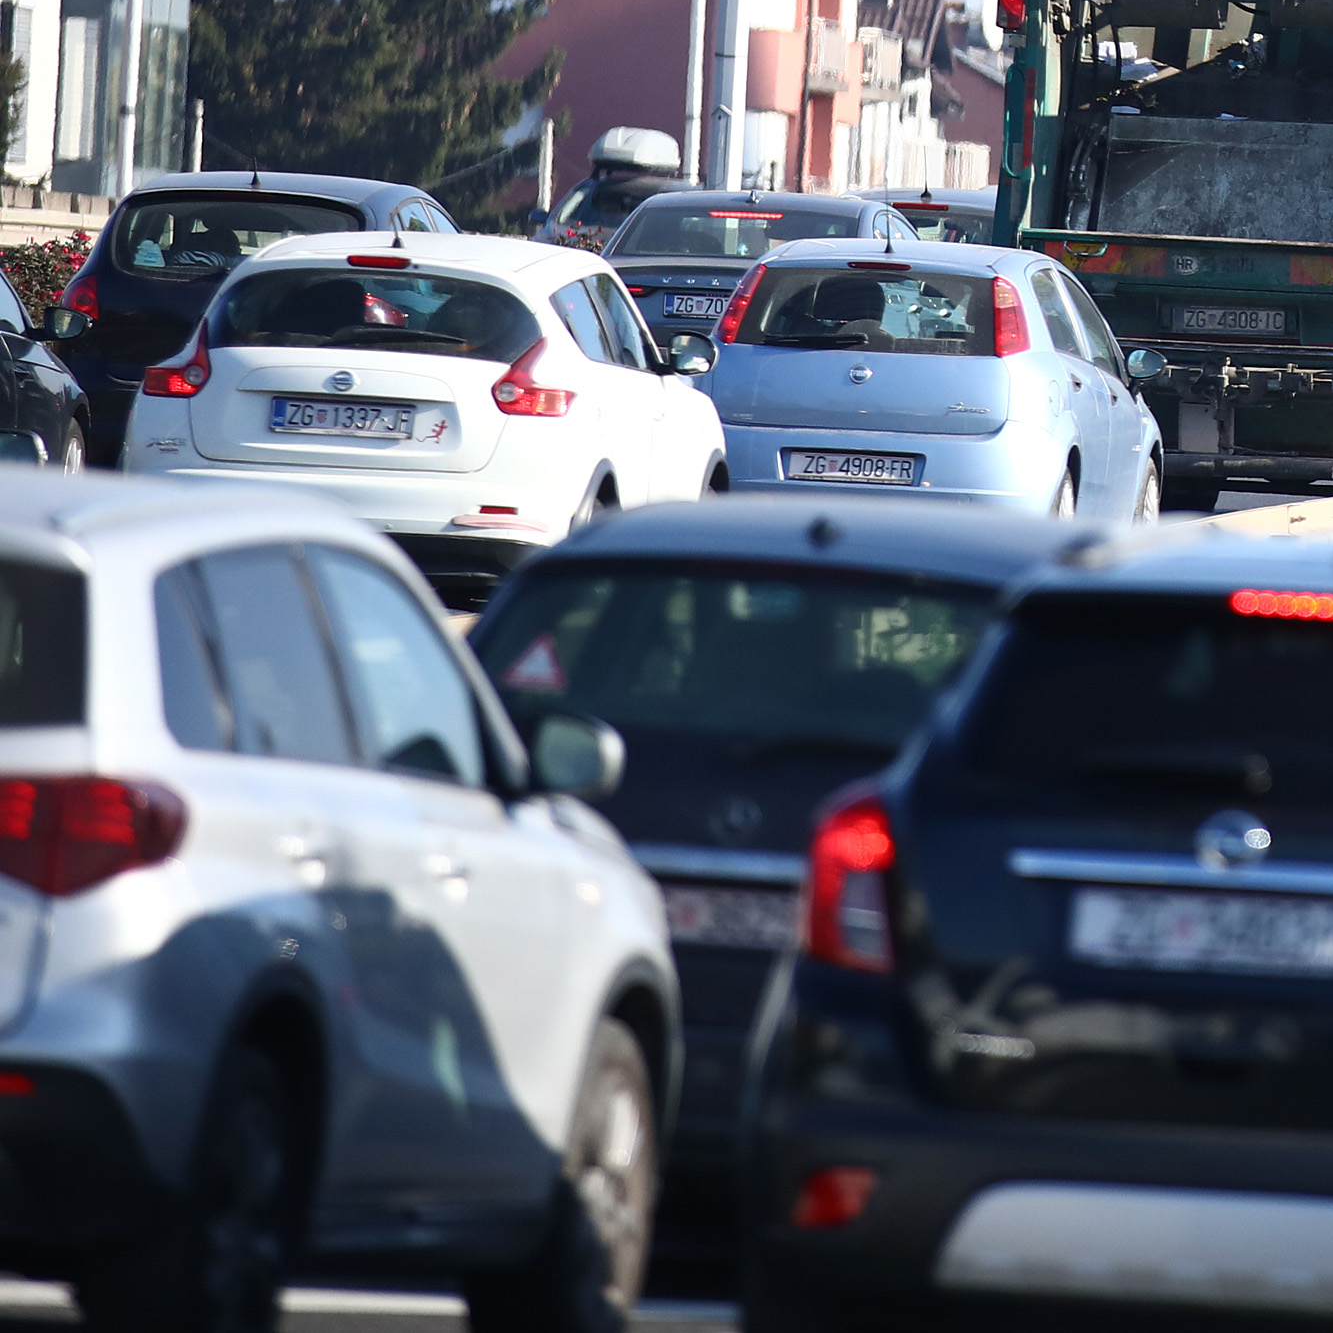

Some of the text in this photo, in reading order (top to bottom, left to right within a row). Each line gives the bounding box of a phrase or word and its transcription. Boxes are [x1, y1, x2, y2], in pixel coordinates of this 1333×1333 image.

[1176, 258, 1194, 270] HR
[675, 297, 729, 314] ZG 70
[1185, 310, 1206, 328] ZG
[287, 404, 315, 426] ZG
[803, 455, 827, 474] ZG
